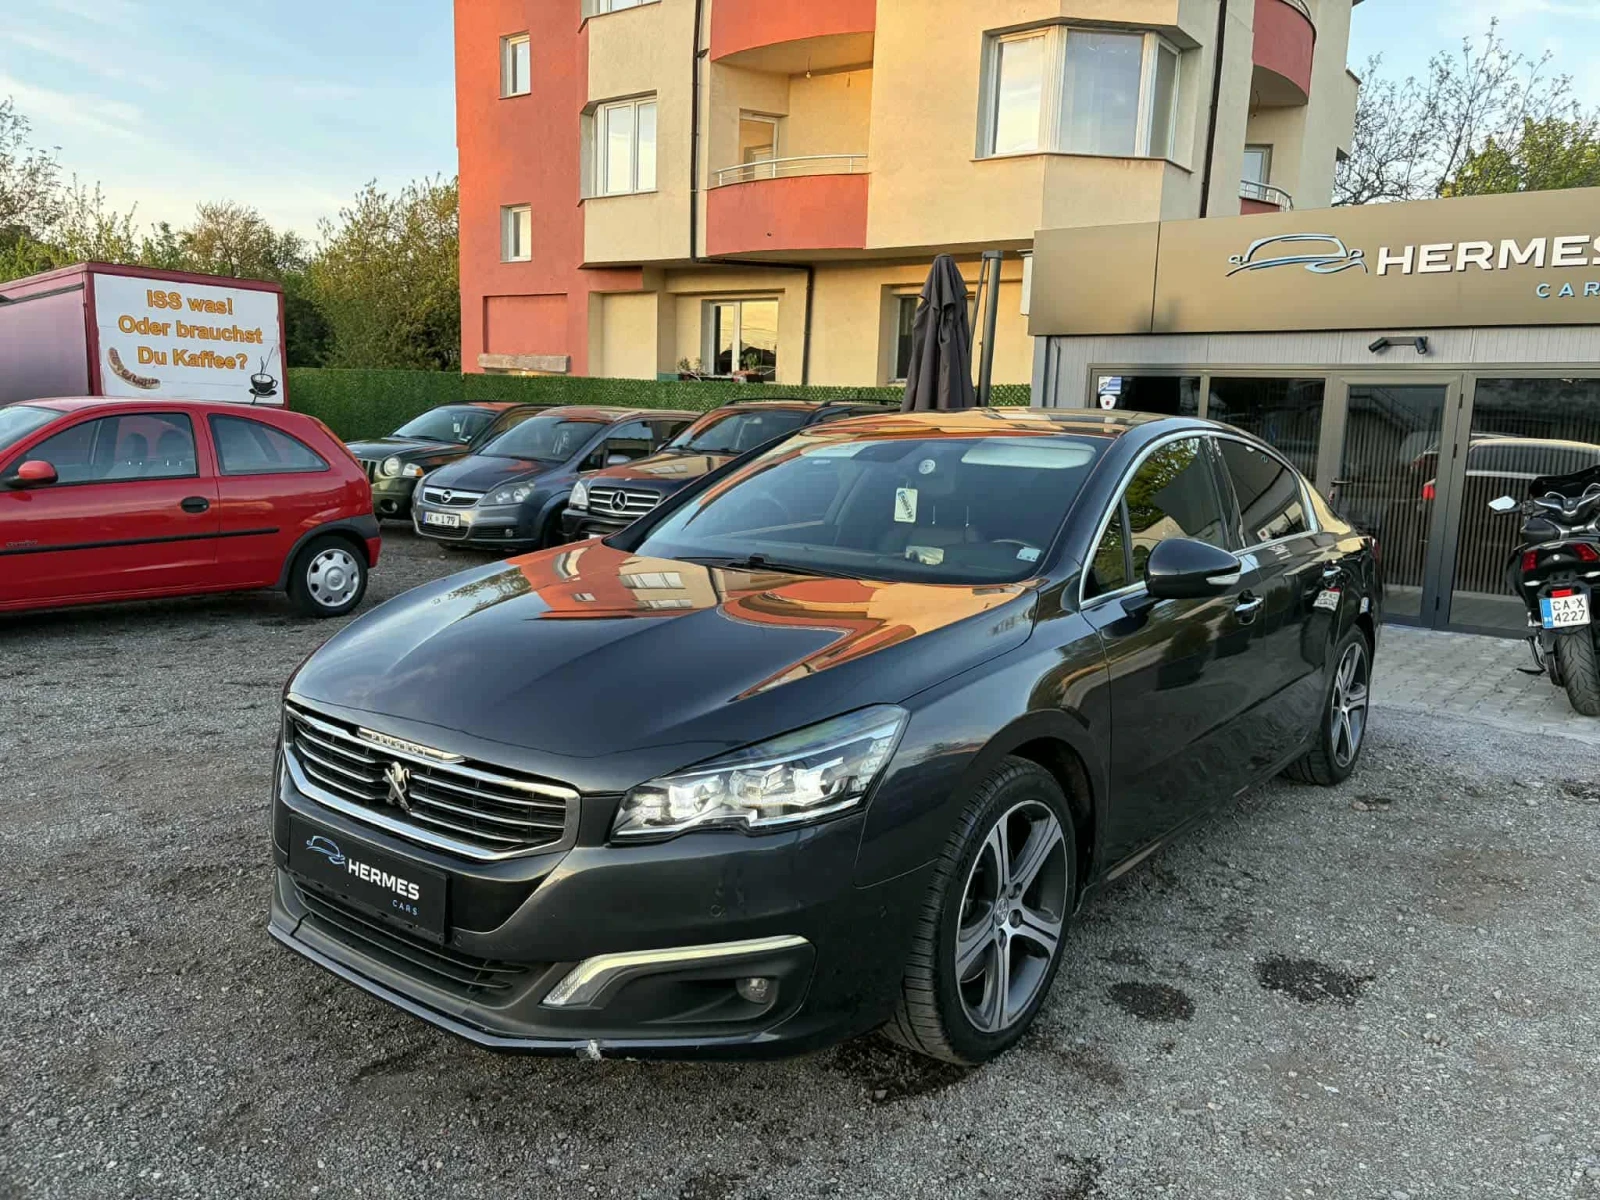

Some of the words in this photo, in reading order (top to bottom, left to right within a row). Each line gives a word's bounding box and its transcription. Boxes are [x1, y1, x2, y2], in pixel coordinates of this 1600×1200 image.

[1376, 234, 1600, 276] HERME
[146, 289, 182, 309] ISS
[187, 297, 233, 315] was!
[118, 315, 171, 336] Oder
[176, 320, 263, 344] brauchst
[137, 346, 167, 366] Du
[173, 349, 248, 370] Kaffee?
[1553, 600, 1570, 611] CA
[1576, 598, 1585, 608] X
[1554, 610, 1585, 622] 4227
[348, 858, 420, 901] HERMES
[392, 899, 419, 916] CARS
